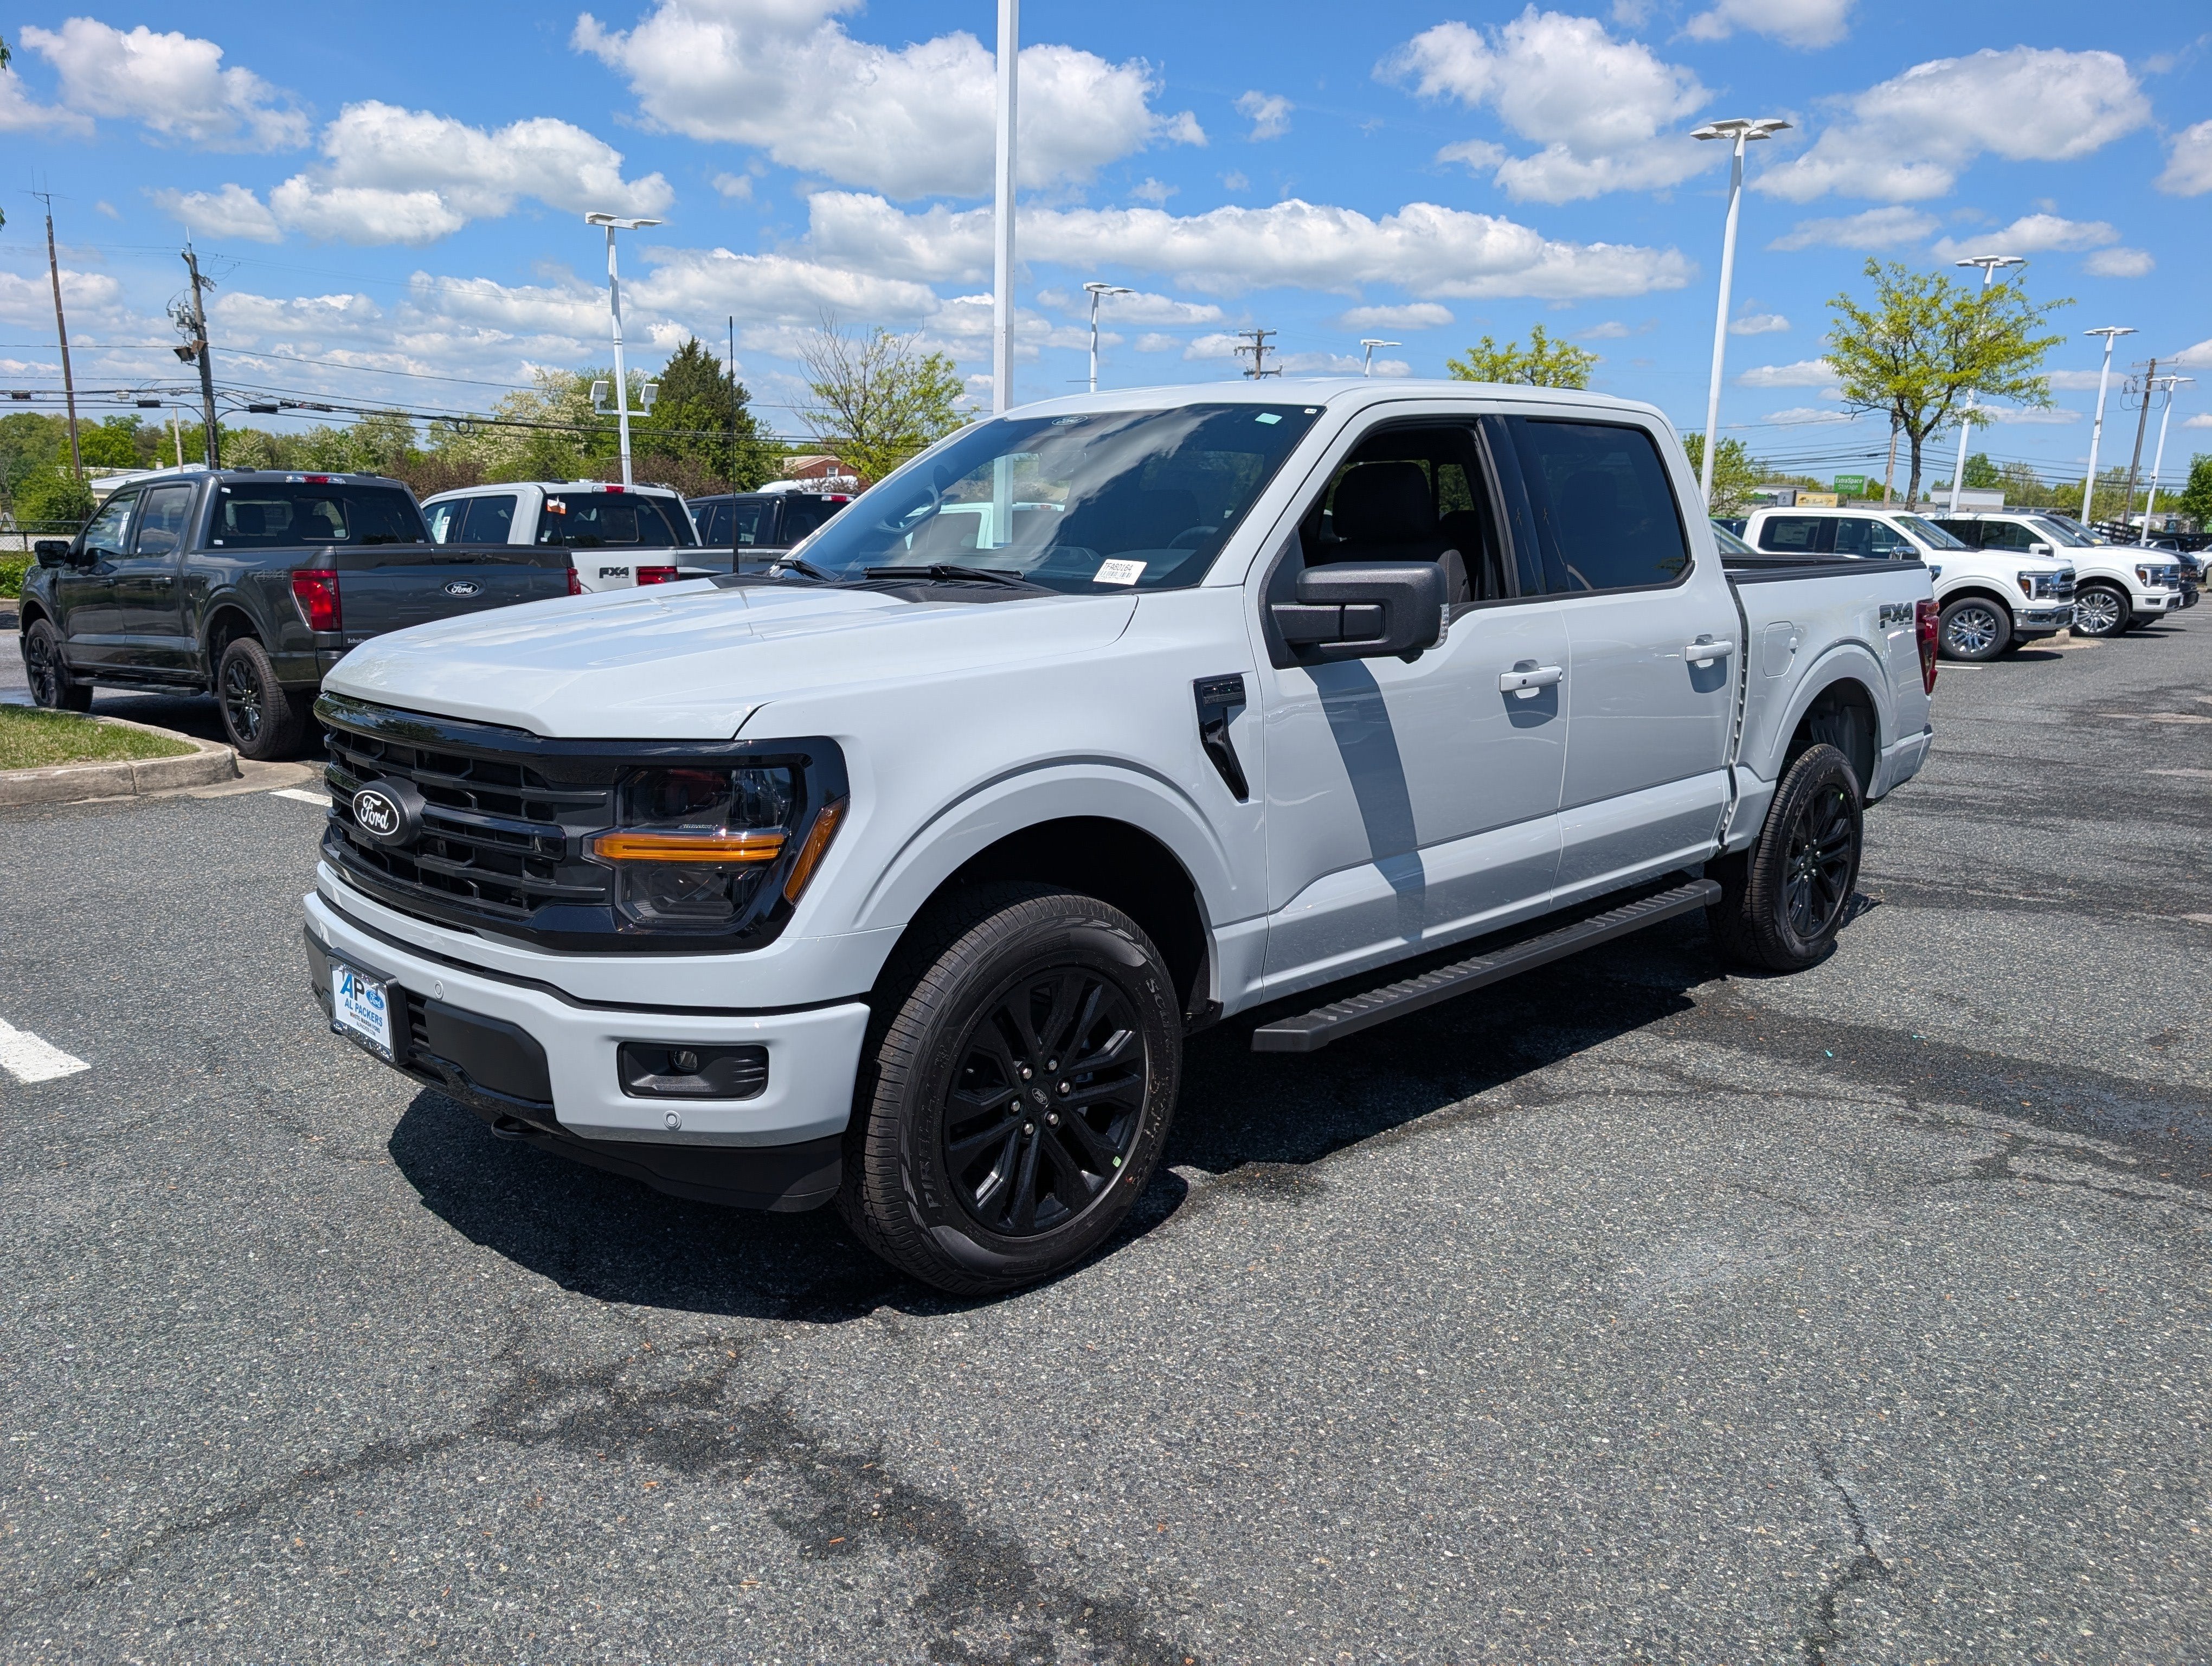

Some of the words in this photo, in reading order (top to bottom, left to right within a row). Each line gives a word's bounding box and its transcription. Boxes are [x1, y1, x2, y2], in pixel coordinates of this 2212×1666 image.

[599, 567, 629, 579] FX4
[1103, 562, 1134, 572] TFA80164
[451, 584, 473, 593] Ford
[1879, 602, 1913, 629] FX4
[361, 795, 389, 830] Ford
[339, 973, 365, 1002] AP
[369, 992, 382, 1008] Ford
[344, 997, 353, 1010] AL
[355, 1003, 383, 1027] PACKERS
